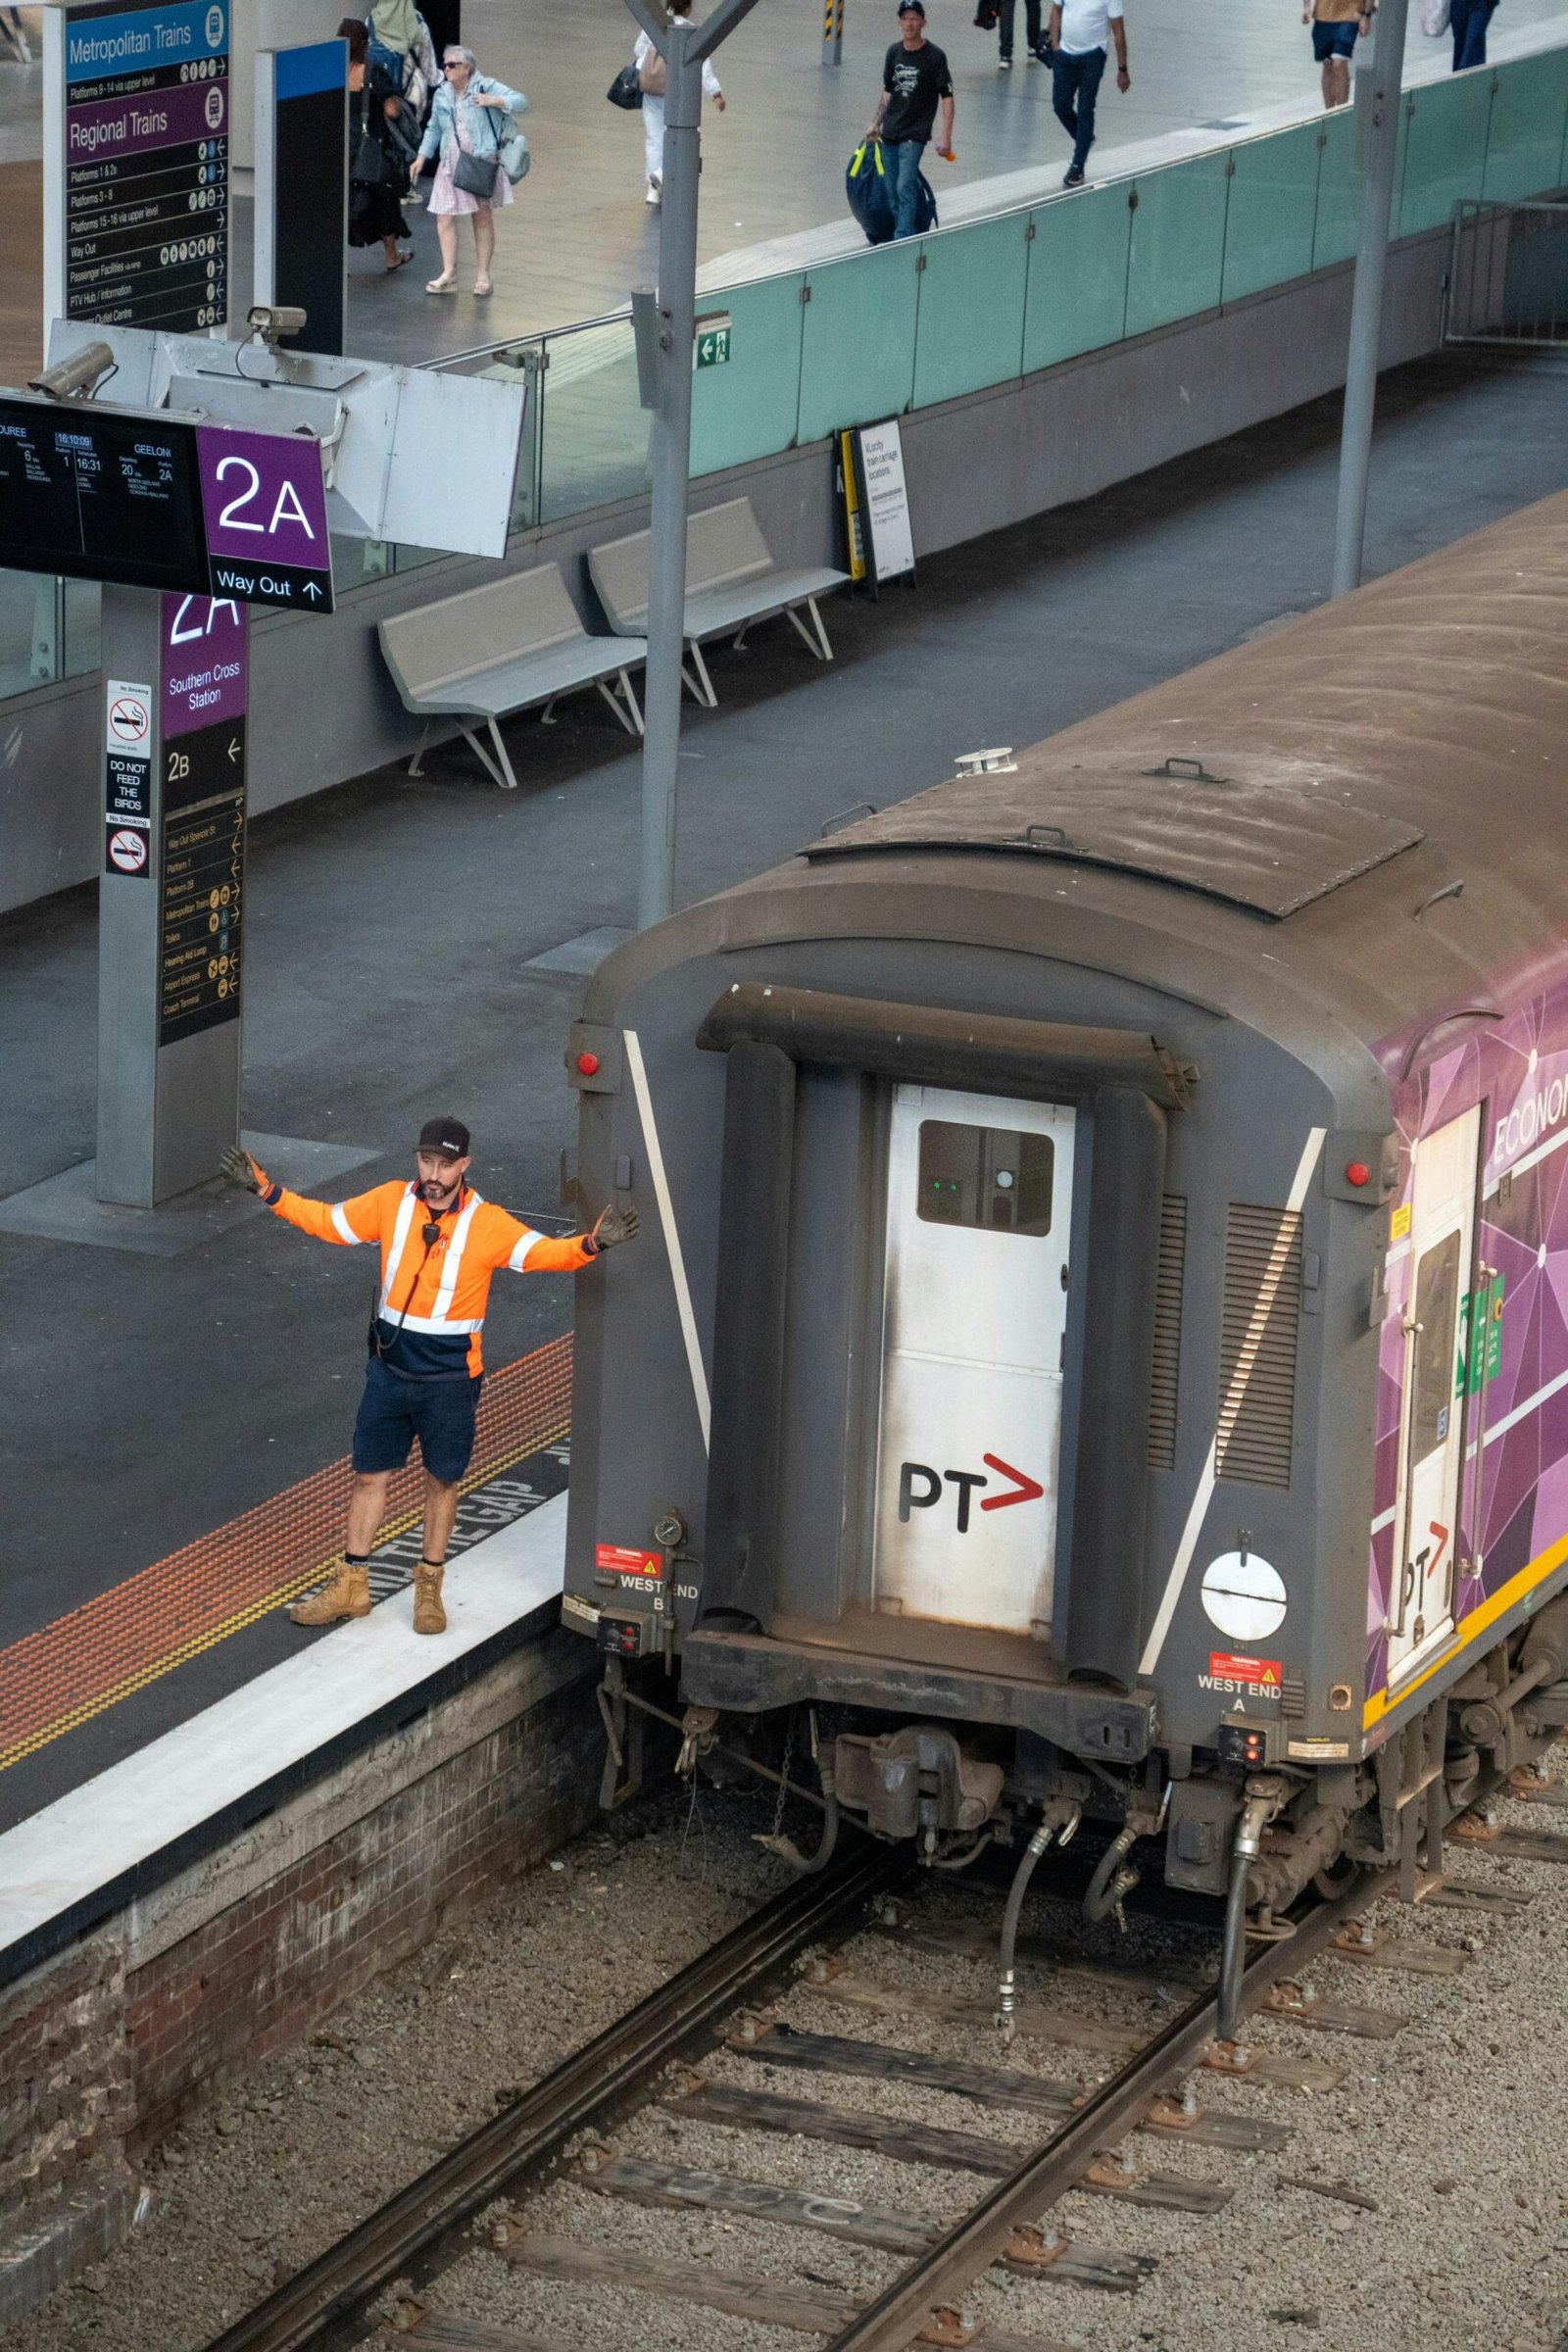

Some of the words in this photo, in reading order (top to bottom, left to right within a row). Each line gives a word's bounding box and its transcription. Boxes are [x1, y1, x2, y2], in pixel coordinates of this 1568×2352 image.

[70, 30, 151, 65] Metropolitan
[154, 23, 191, 49] Trains
[71, 85, 98, 100] Platforms
[115, 79, 123, 91] via
[123, 76, 142, 91] upper
[142, 73, 156, 86] level
[71, 114, 126, 151] Regional
[130, 109, 168, 137] Trains
[71, 169, 98, 183] Platforms
[71, 193, 98, 209] Platforms
[71, 218, 98, 233] Platforms
[119, 212, 128, 221] via
[127, 208, 145, 223] upper
[145, 204, 159, 218] level
[71, 245, 84, 259] Way
[84, 242, 96, 255] Out
[70, 267, 100, 283] Passenger
[100, 261, 124, 277] Facilities
[70, 294, 82, 308] PTV
[84, 291, 96, 304] Hub
[101, 283, 132, 300] Information
[113, 307, 133, 322] Centre
[59, 432, 90, 447] 16:10:09
[24, 450, 31, 462] 6
[64, 456, 70, 467] 1
[77, 457, 101, 471] 16:31
[121, 464, 133, 476] 20
[159, 468, 173, 481] 2A
[216, 456, 316, 540] 2A
[217, 570, 255, 594] Way
[259, 576, 292, 597] Out
[170, 670, 212, 696] Southern
[213, 661, 241, 682] Cross
[188, 688, 221, 710] Station
[110, 760, 125, 771] DO
[126, 763, 147, 774] NOT
[168, 752, 190, 782] 2B
[117, 773, 140, 785] FEED
[119, 786, 138, 798] THE
[115, 798, 142, 810] BIRDS
[109, 814, 119, 823] No
[119, 816, 147, 827] Smoking
[179, 835, 189, 846] Out
[167, 861, 187, 874] Platform
[166, 884, 186, 898] Platform
[166, 904, 195, 921] Metropolitan
[165, 932, 180, 944] Toilets
[165, 955, 184, 968] Hearing
[184, 948, 194, 959] Aid
[194, 946, 208, 958] Loop
[164, 980, 180, 993] Airport
[180, 972, 201, 986] Express
[164, 1002, 179, 1015] Coach
[180, 994, 200, 1008] Terminal
[456, 1480, 548, 1523] GAP
[620, 1575, 664, 1593] WEST
[673, 1584, 698, 1599] ND
[655, 1597, 664, 1610] B
[1198, 1675, 1245, 1693] WEST
[1249, 1683, 1282, 1699] END
[1233, 1698, 1246, 1712] A
